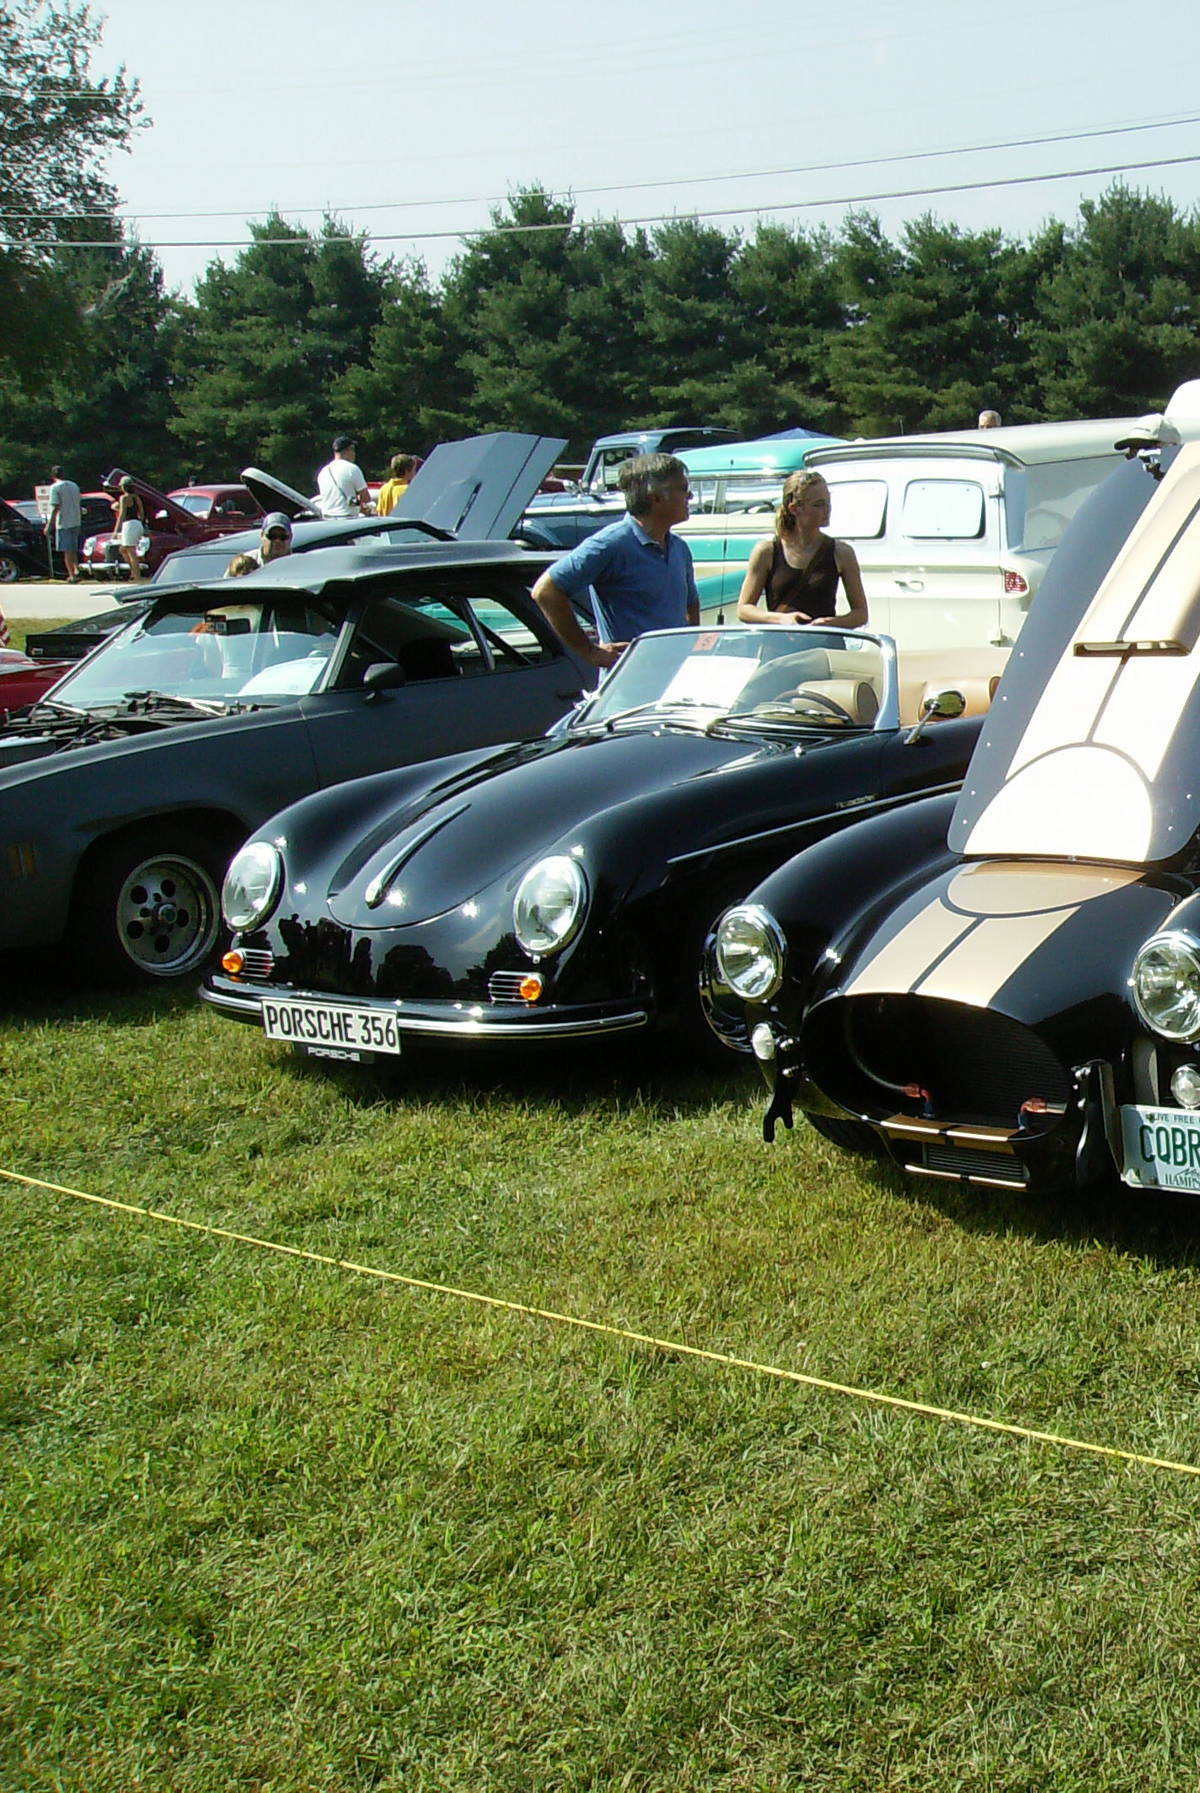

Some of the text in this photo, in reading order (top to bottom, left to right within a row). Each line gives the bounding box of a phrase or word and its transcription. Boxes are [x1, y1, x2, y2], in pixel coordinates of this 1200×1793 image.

[266, 1005, 397, 1048] PORSCHE 356
[307, 1046, 361, 1062] PORSCHE
[1154, 1112, 1169, 1122] LIVE
[1173, 1114, 1195, 1125] FREE
